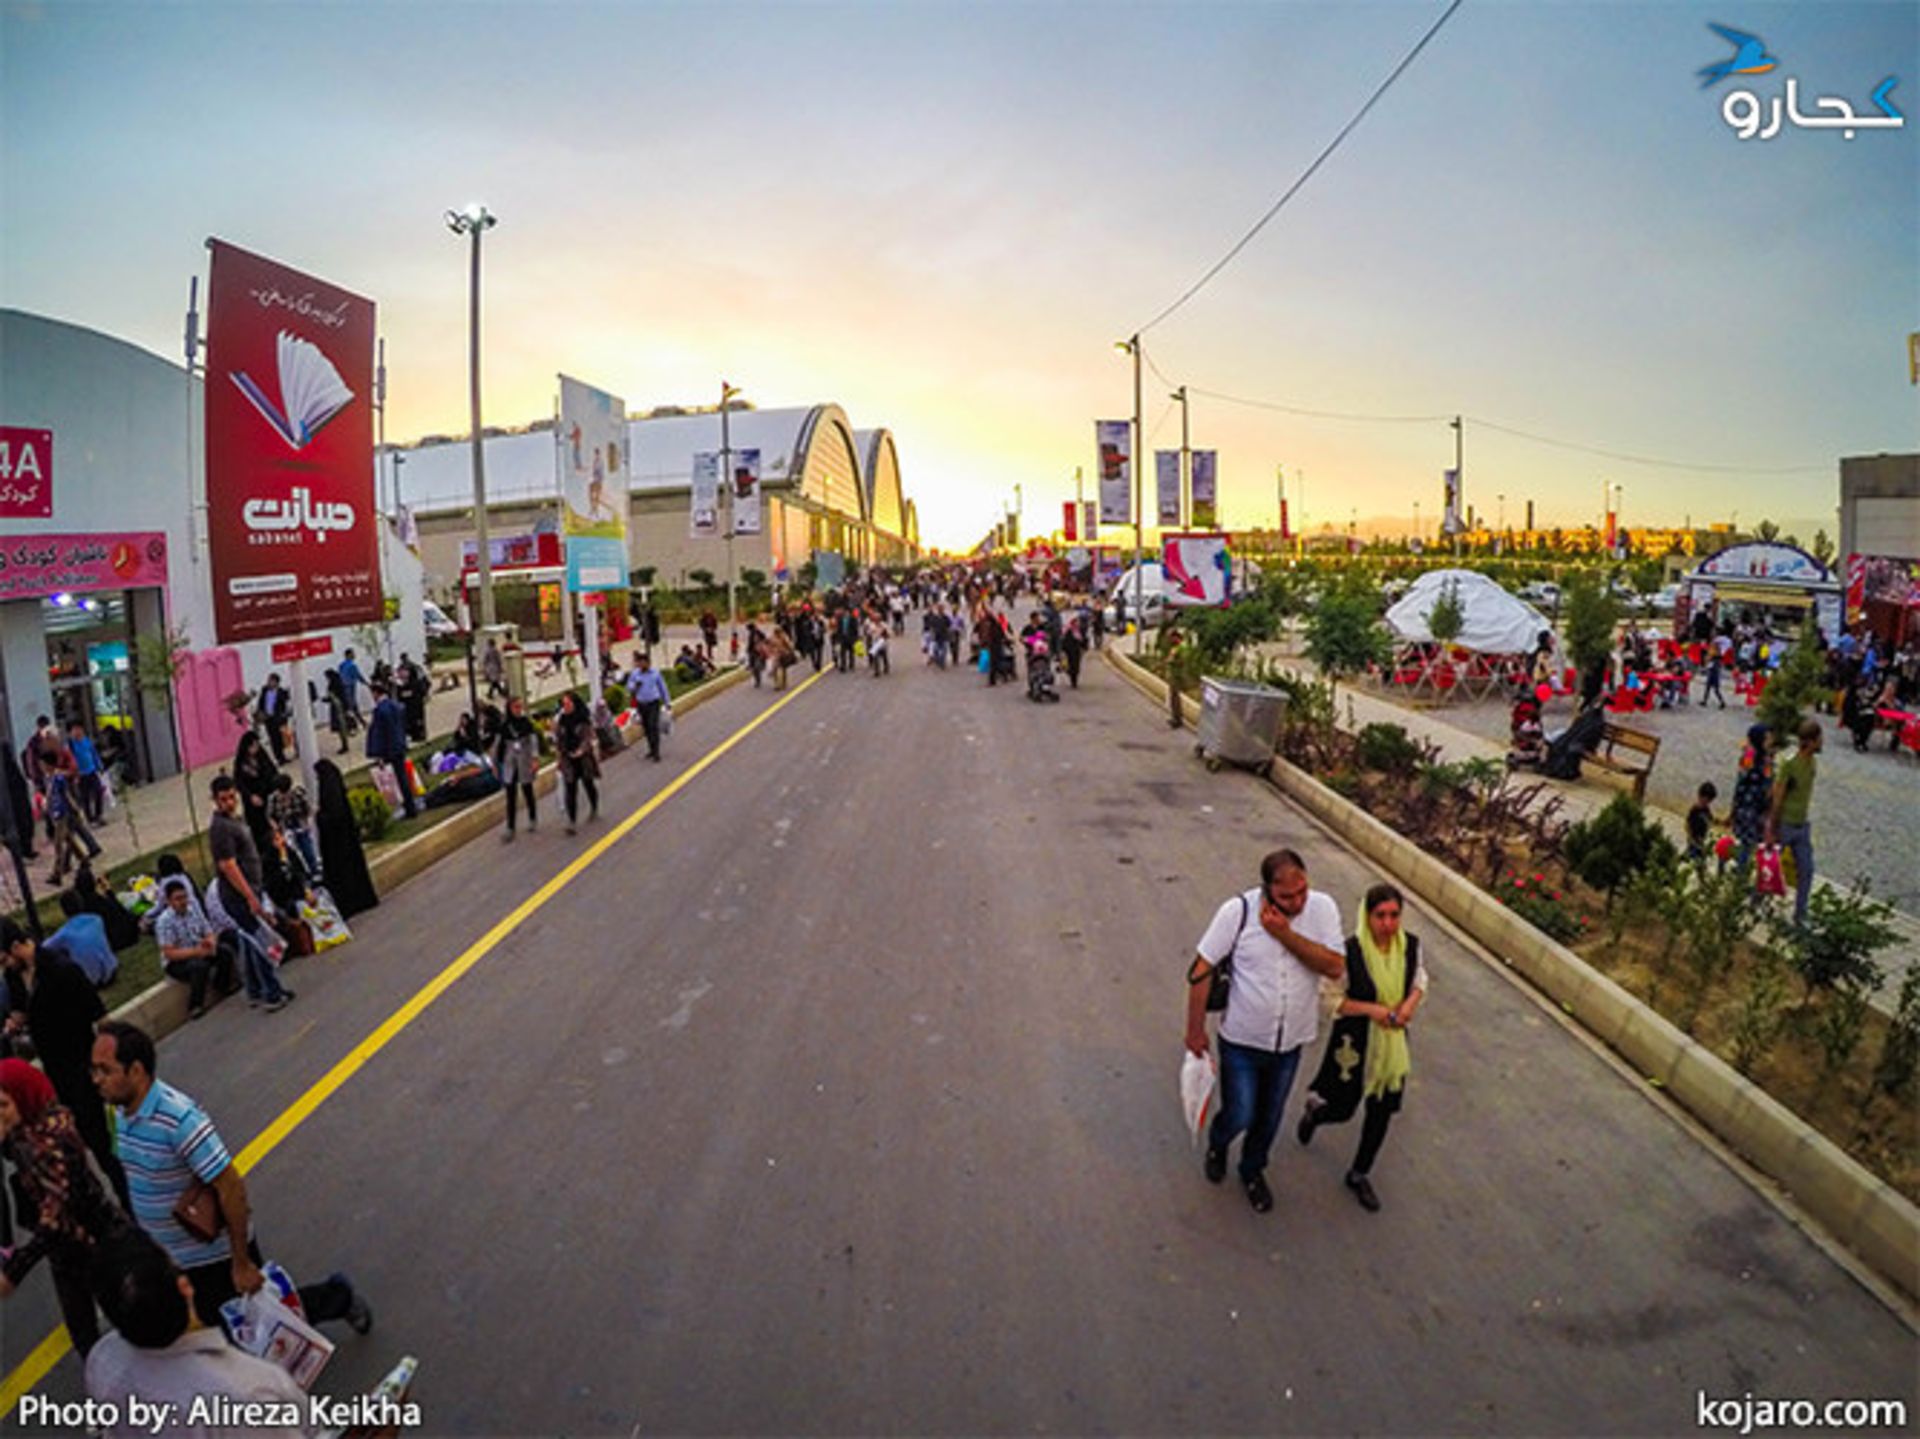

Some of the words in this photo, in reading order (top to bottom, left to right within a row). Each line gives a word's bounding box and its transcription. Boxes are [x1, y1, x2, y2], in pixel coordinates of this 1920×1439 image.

[0, 441, 42, 480] 4A
[0, 484, 39, 506] کودک
[243, 487, 355, 543] صبانت
[12, 544, 57, 568] کودک
